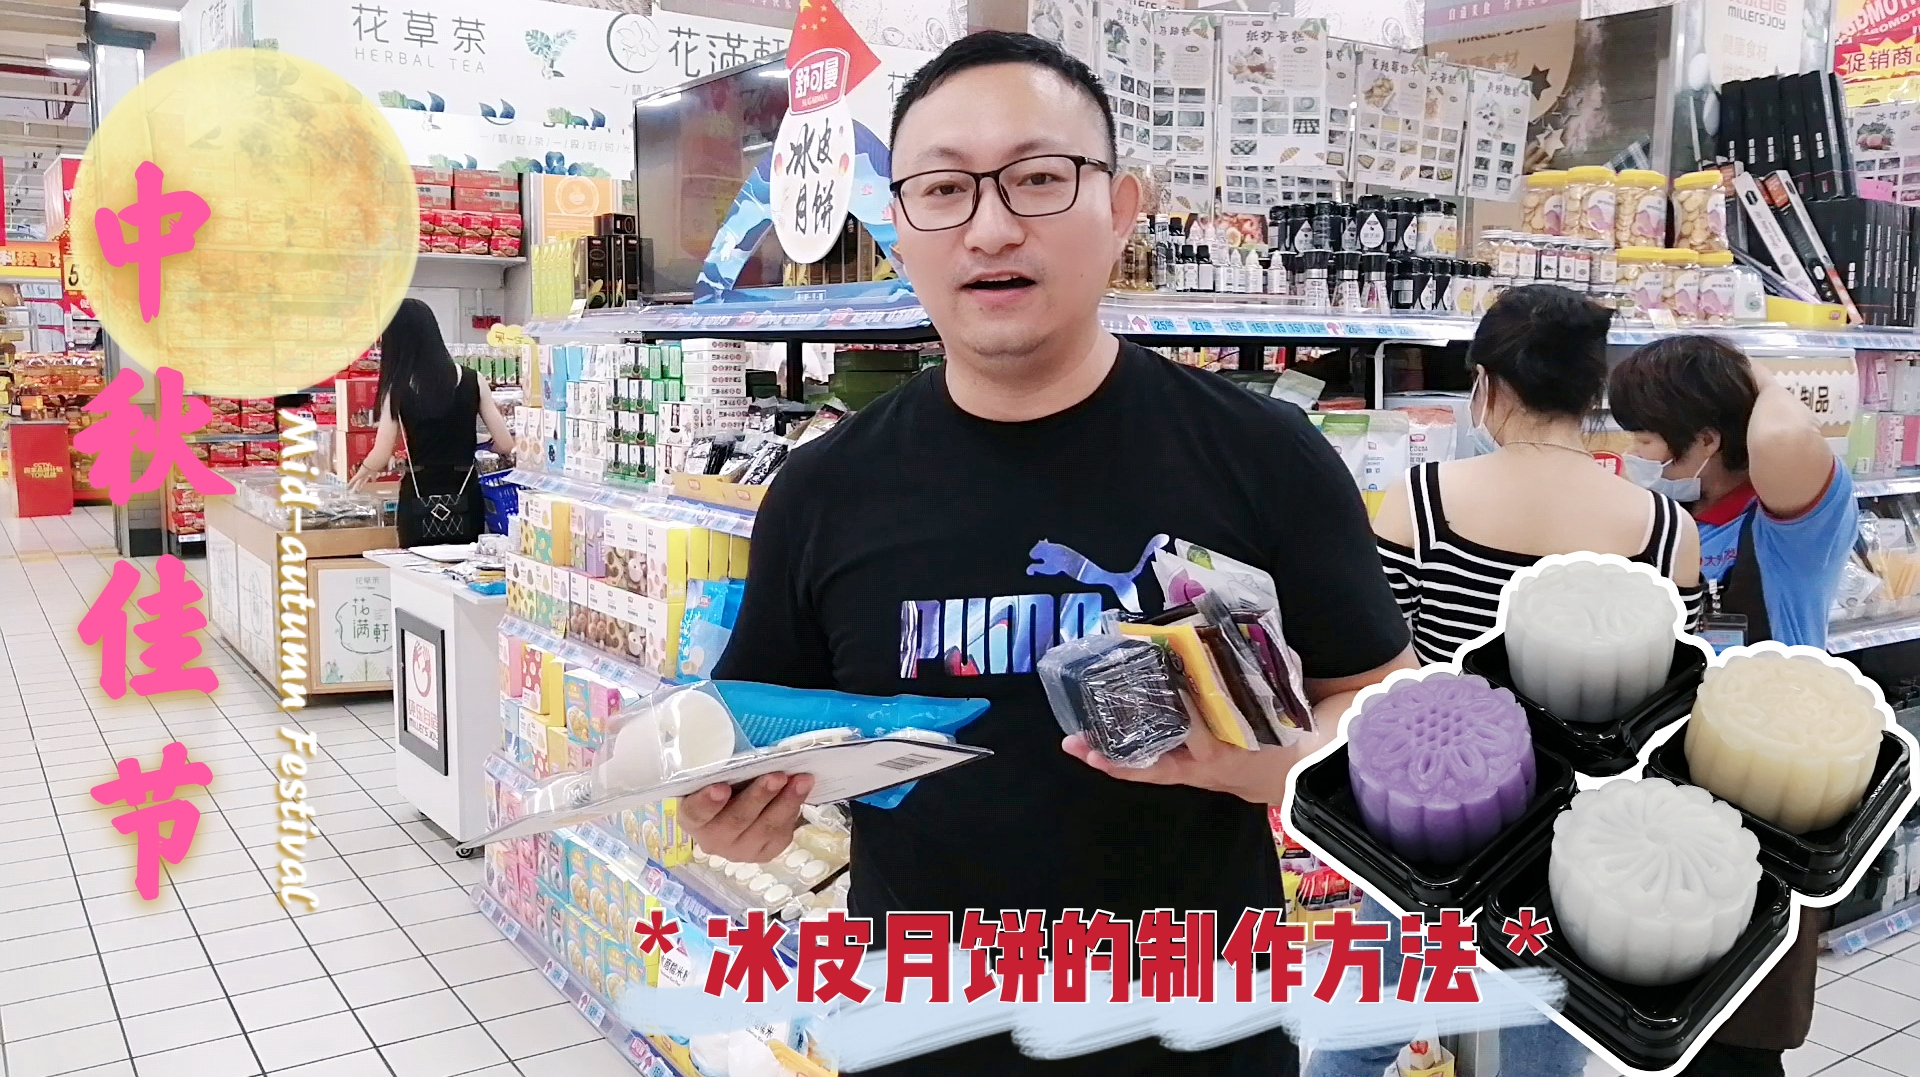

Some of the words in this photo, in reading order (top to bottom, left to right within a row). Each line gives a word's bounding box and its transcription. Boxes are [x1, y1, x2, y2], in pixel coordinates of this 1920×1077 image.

[351, 3, 486, 55] 花草茶
[355, 47, 435, 69] HERBAL
[450, 58, 486, 74] TEA
[795, 56, 839, 99] 舒可曼
[1846, 45, 1920, 73] 促销商
[786, 118, 833, 179] 冰皮
[795, 179, 835, 235] 月饼
